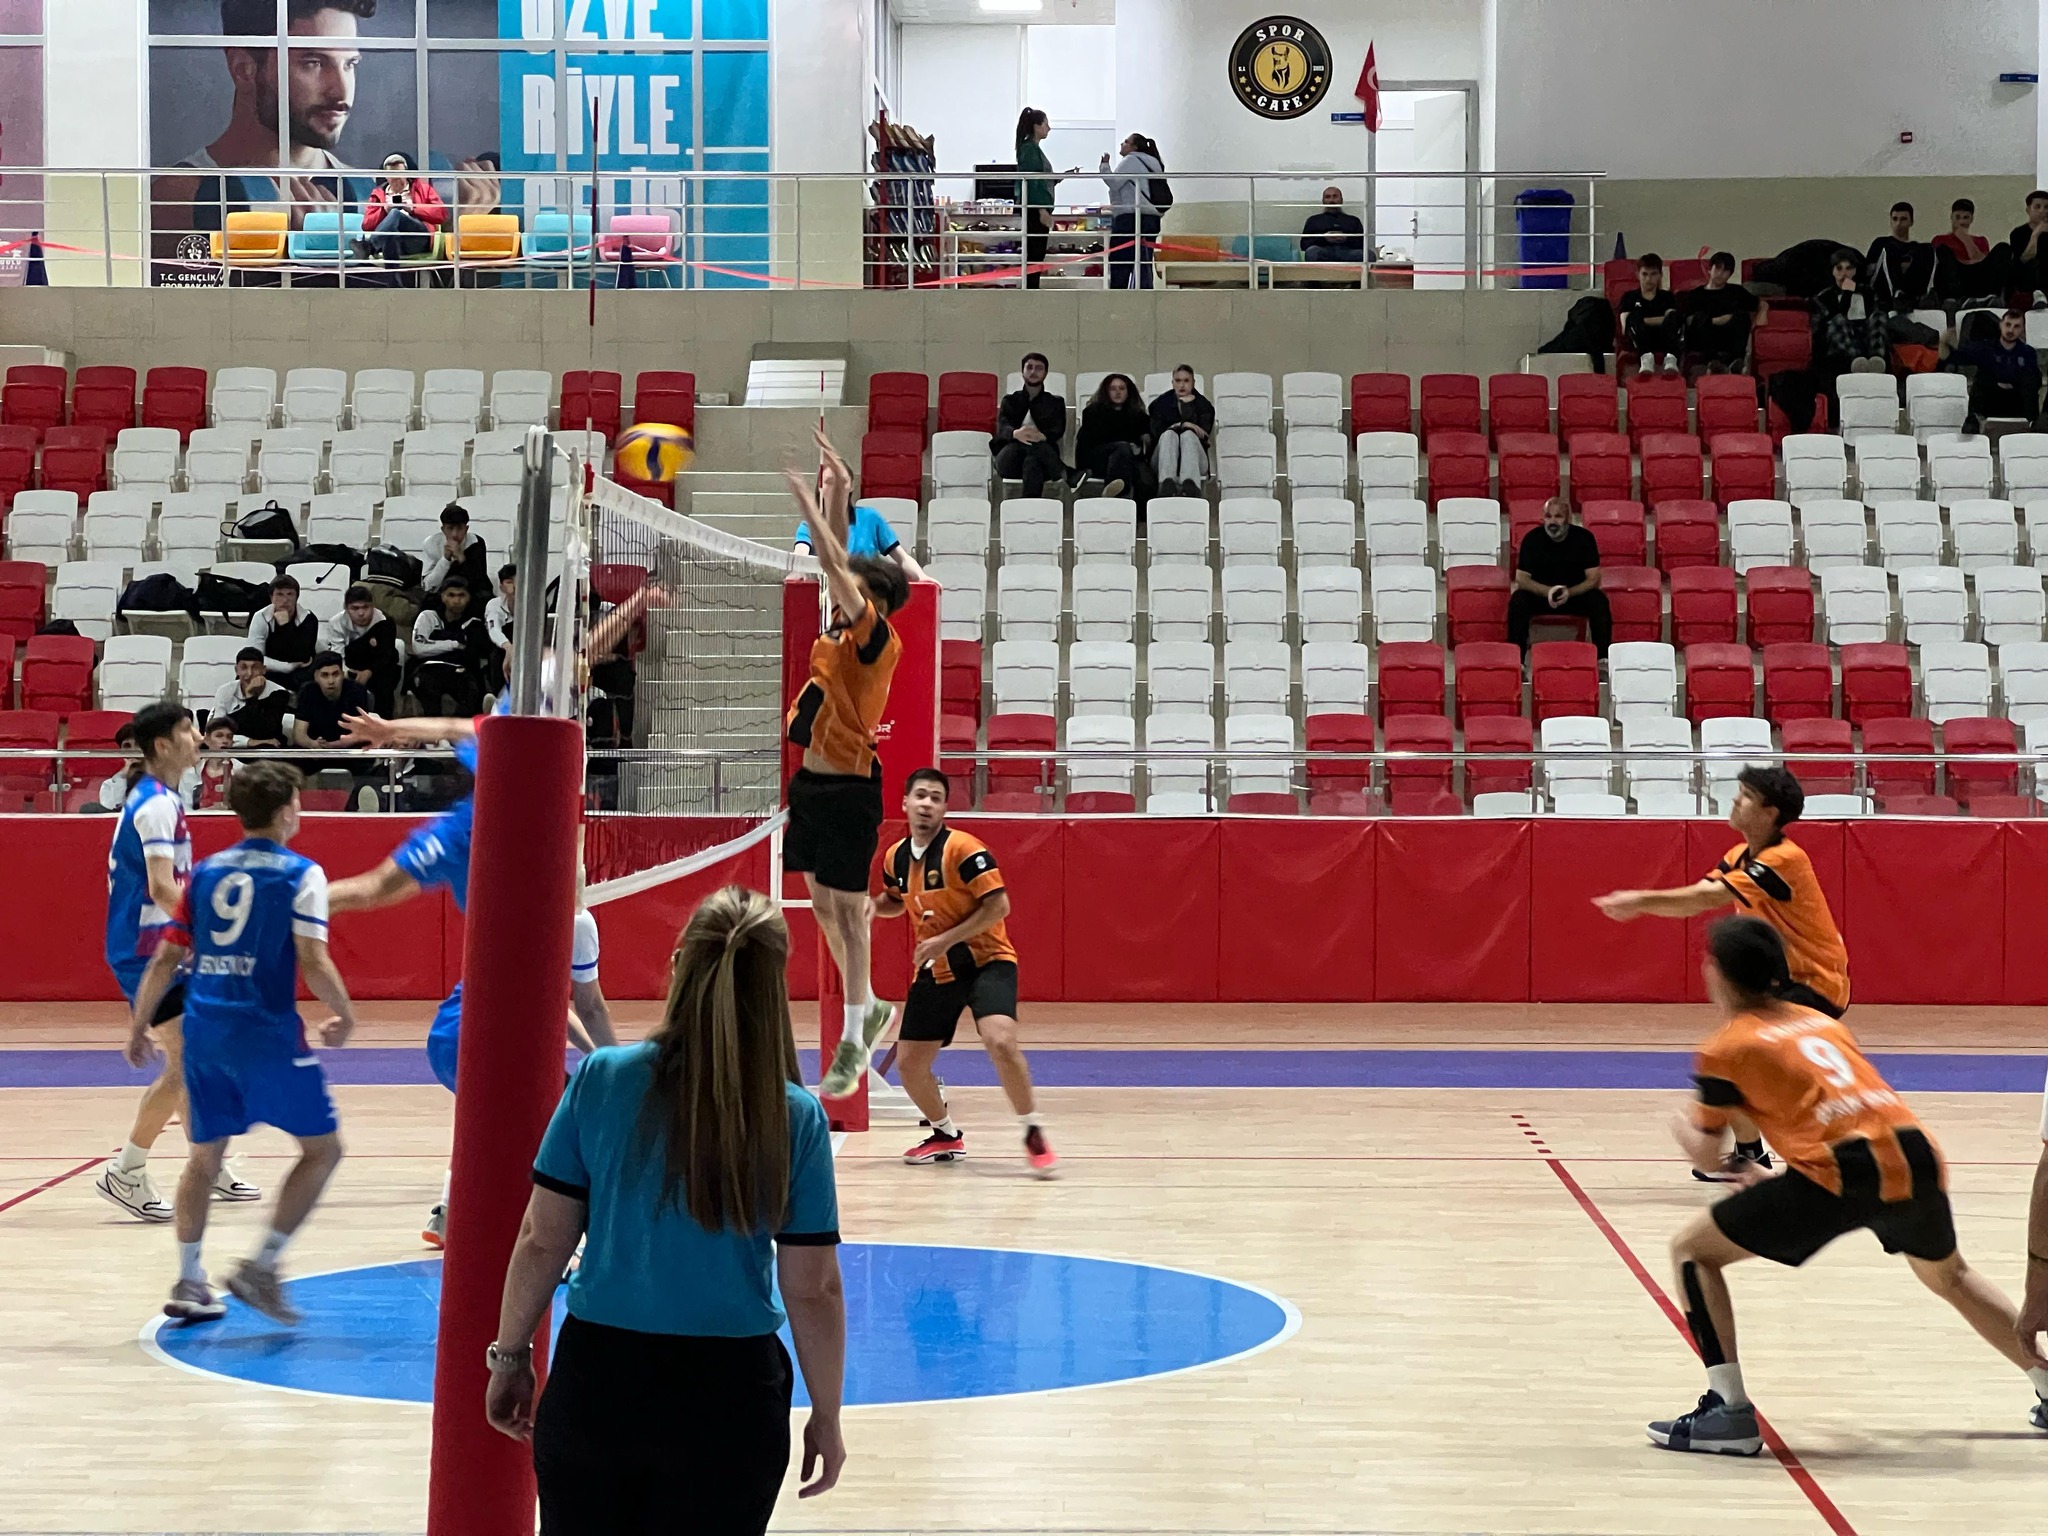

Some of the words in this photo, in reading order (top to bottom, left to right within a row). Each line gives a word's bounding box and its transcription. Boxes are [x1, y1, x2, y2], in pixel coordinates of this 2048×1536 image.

[1256, 25, 1305, 41] SPOR
[1257, 96, 1303, 111] CAFE
[160, 273, 176, 281] T.C.
[178, 273, 216, 282] GENÇLİK
[210, 872, 255, 946] 9
[1797, 1036, 1856, 1088] 9
